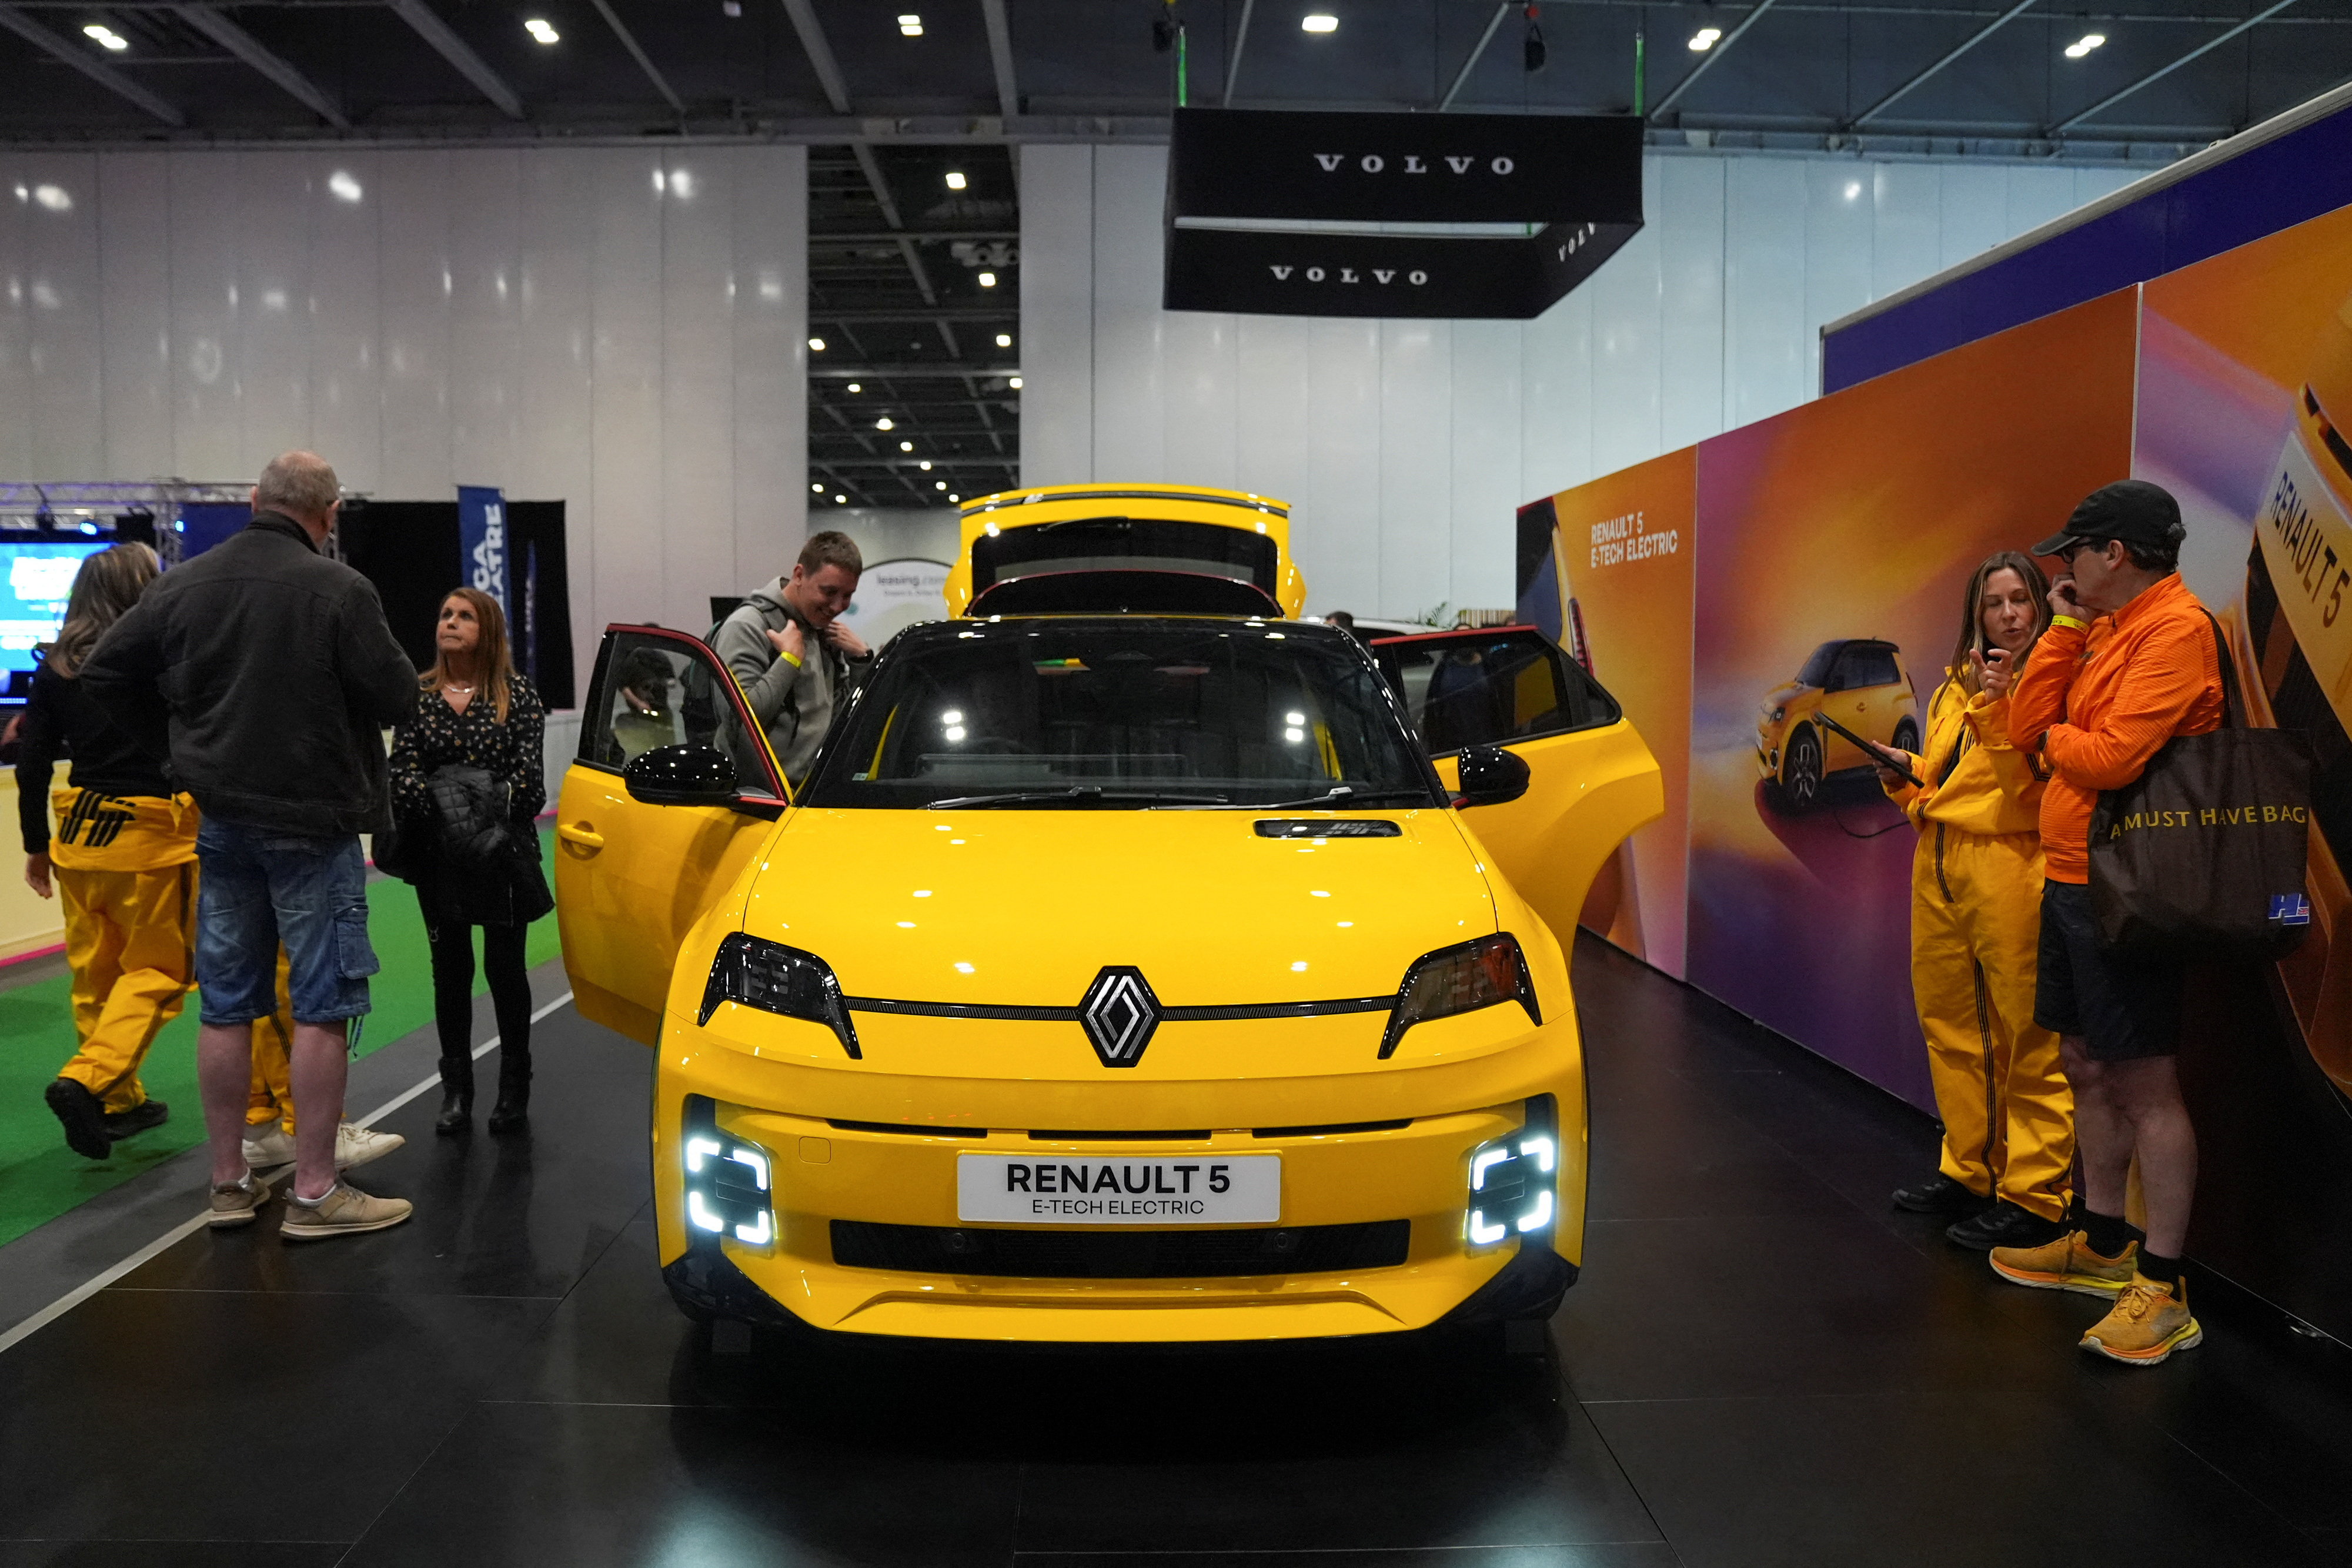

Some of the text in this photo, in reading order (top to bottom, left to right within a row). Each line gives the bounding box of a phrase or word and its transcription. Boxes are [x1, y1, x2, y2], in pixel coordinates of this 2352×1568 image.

[1314, 153, 1515, 175] VOLVO
[1558, 221, 1596, 262] VOLV
[1269, 265, 1428, 286] VOLVO
[1591, 511, 1644, 545] RENAULT 5
[1591, 529, 1678, 569] E-TECH ELECTRIC
[2270, 470, 2351, 628] RENAULT 5
[2110, 805, 2306, 840] A MUST HAVE BAG
[1007, 1164, 1231, 1194] RENAULT 5
[1032, 1199, 1204, 1215] E-TECH ELECTRIC
